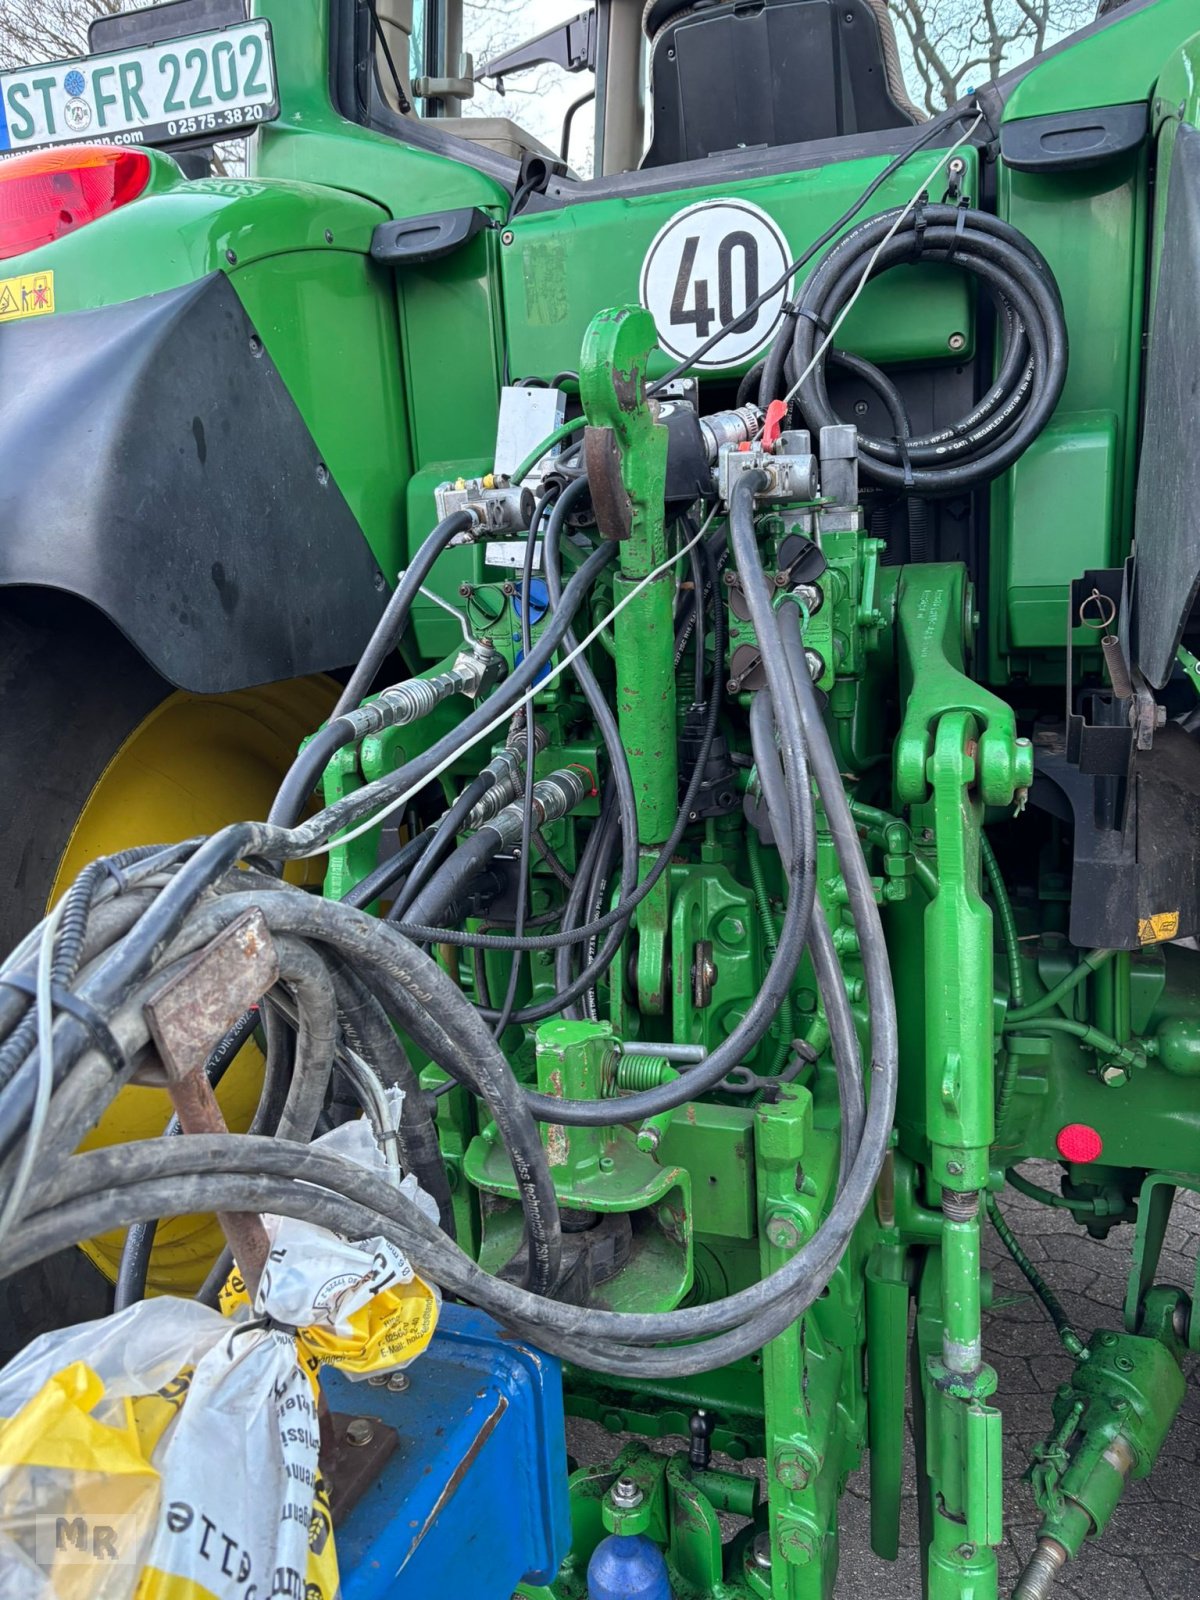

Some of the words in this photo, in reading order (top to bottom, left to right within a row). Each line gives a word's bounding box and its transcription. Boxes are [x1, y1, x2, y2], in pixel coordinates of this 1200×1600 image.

[7, 77, 57, 140] ST
[91, 61, 149, 127] FR
[159, 34, 267, 114] 2202
[670, 230, 759, 338] 40
